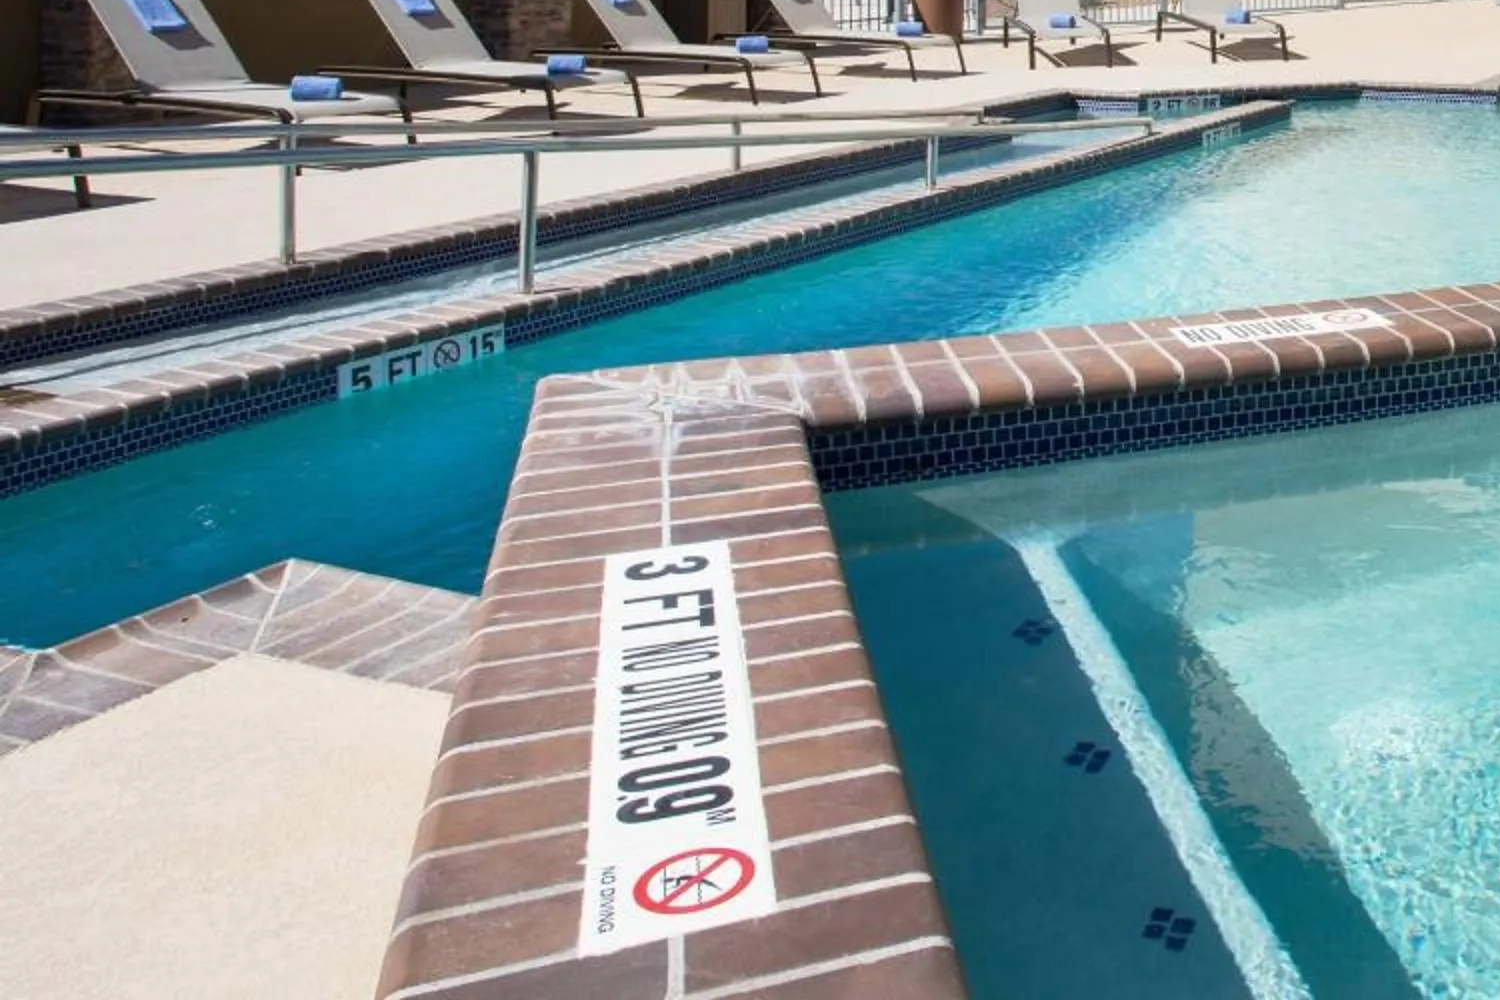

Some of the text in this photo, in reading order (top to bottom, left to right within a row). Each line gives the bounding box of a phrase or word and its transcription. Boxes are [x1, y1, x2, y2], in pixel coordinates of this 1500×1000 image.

[1179, 317, 1318, 343] NO DIVING
[351, 364, 373, 392] 5
[388, 350, 423, 385] FT
[623, 555, 709, 581] 3
[621, 588, 716, 631] FT
[621, 635, 721, 672] NO
[619, 670, 729, 761] DIVING
[598, 865, 616, 934] NO DIVING
